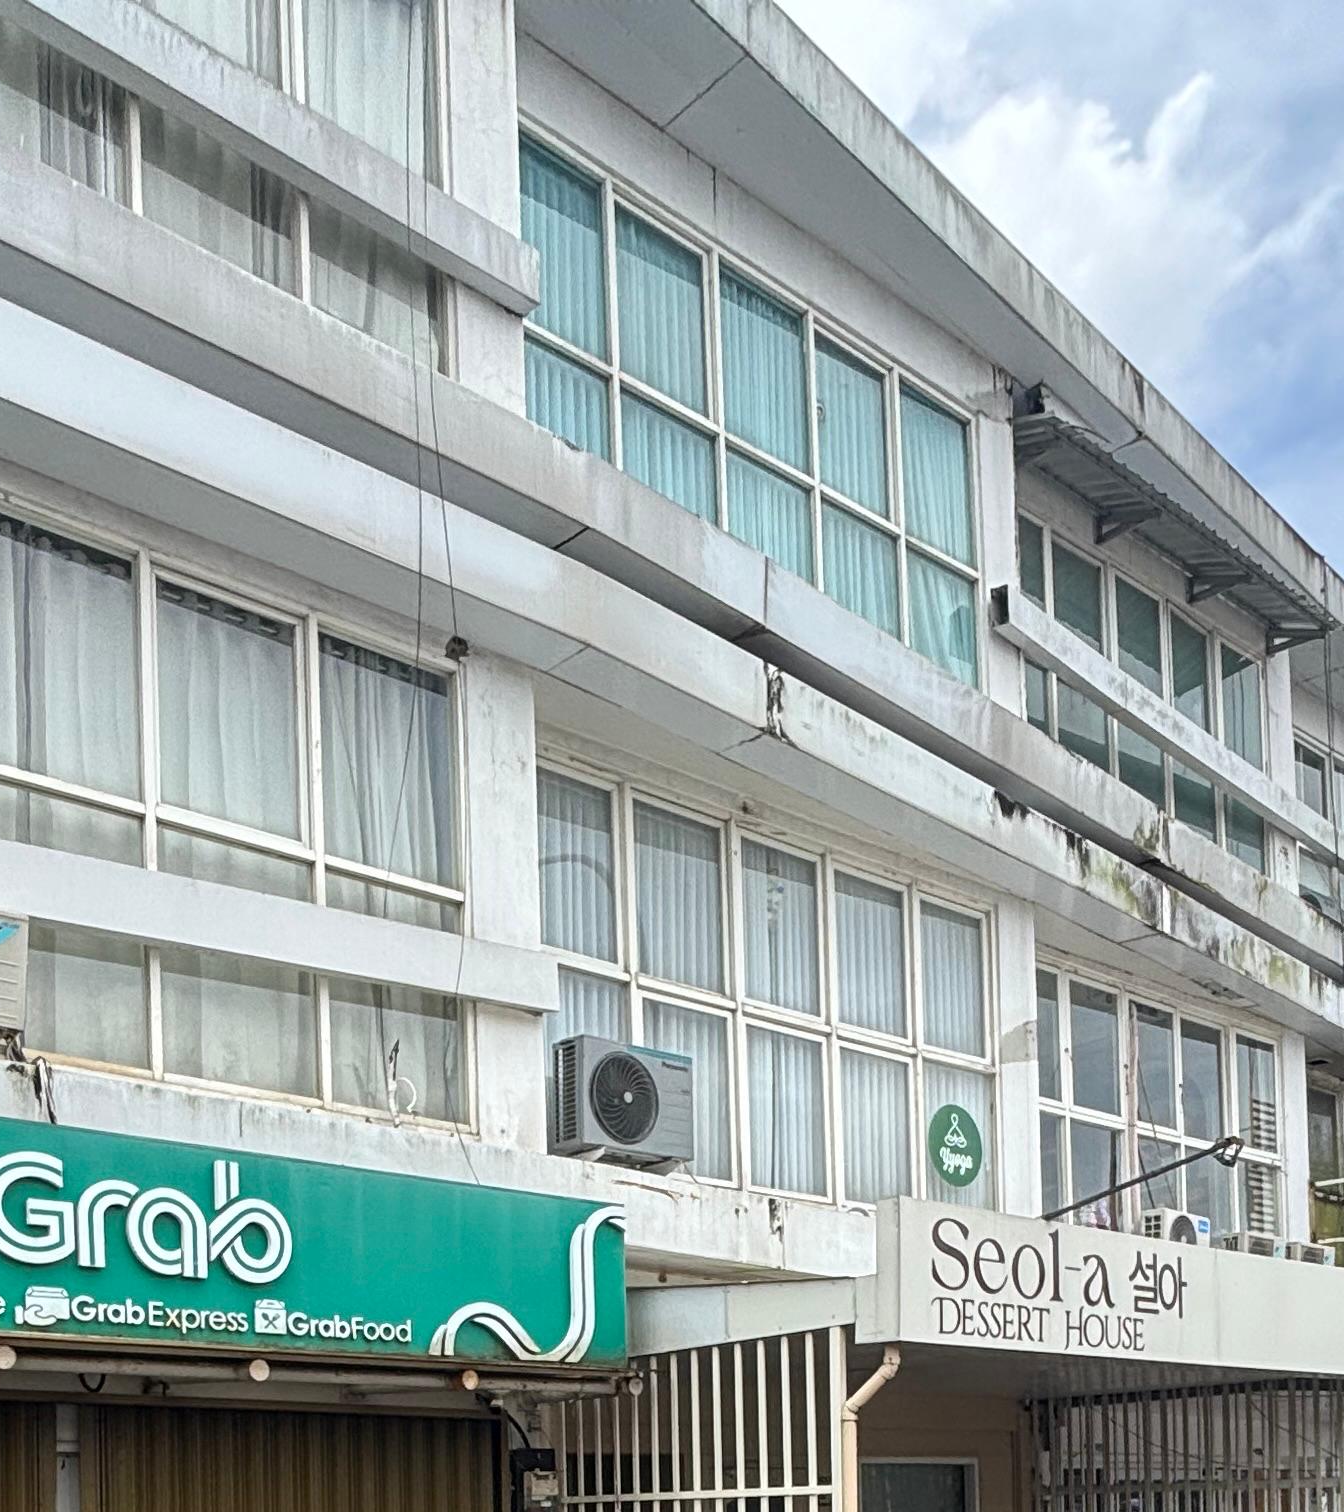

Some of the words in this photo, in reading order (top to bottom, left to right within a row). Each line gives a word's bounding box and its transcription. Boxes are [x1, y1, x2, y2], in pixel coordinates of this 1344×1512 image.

[931, 1217, 1115, 1309] Seol-a
[1128, 1250, 1187, 1319] 설아
[930, 1296, 1050, 1343] DESSERT
[1064, 1306, 1145, 1351] HOUSE
